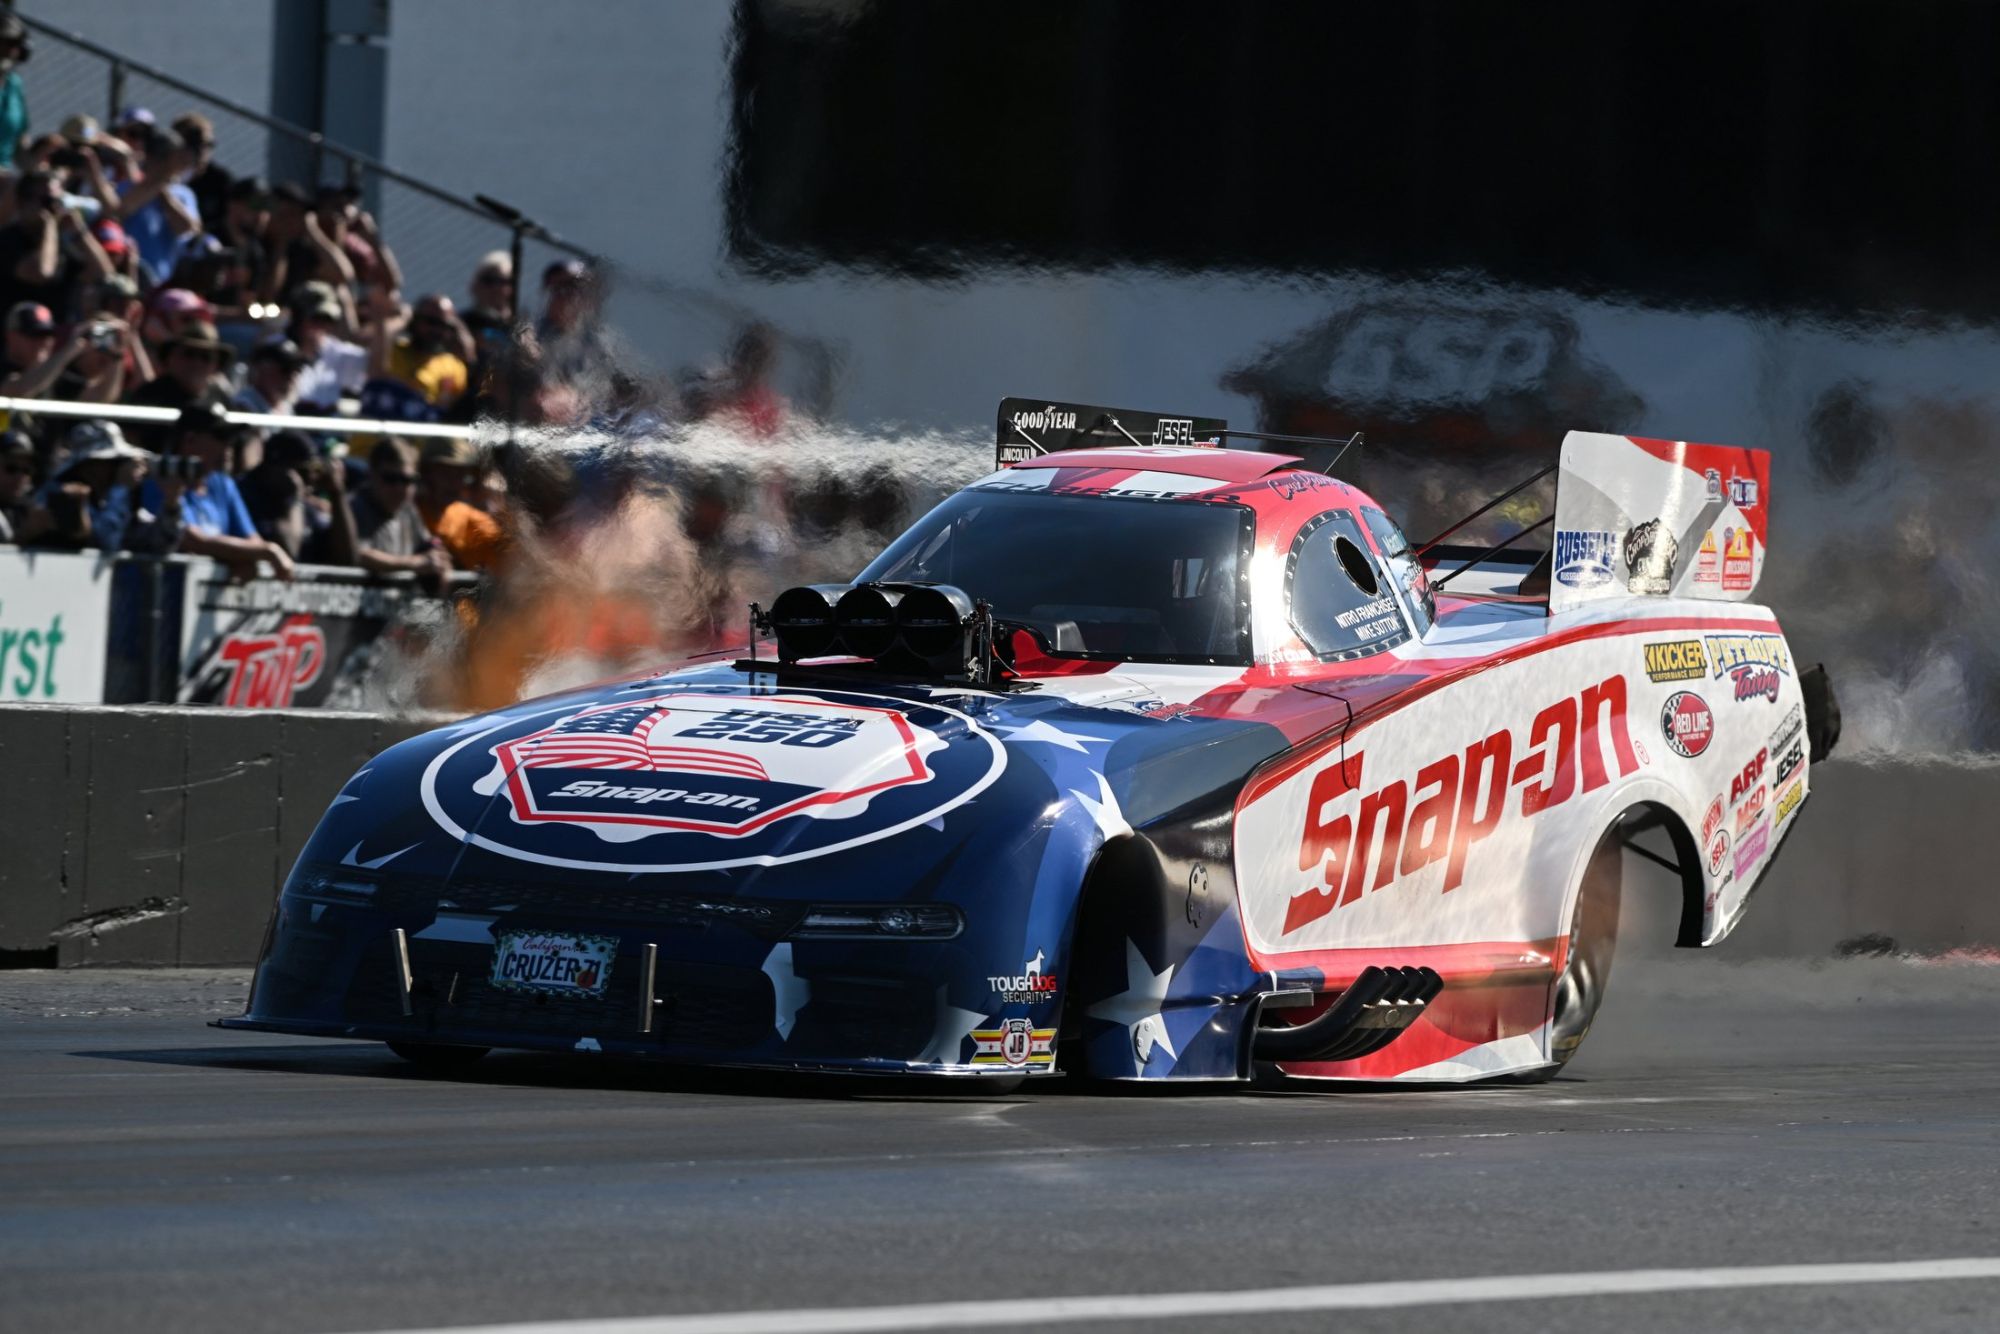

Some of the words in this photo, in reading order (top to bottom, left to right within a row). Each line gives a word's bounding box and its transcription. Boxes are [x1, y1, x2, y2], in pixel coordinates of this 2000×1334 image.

[1153, 418, 1195, 447] JESEL
[1000, 447, 1030, 462] LINCOLN
[1334, 609, 1360, 629] NITRO
[1357, 597, 1397, 623] FRANCHISEE
[1355, 623, 1377, 641] MIKE
[1375, 617, 1400, 636] SUTTON
[0, 612, 64, 697] rst
[1655, 641, 1706, 671] KICKER
[673, 721, 857, 748] 250
[713, 709, 865, 732] USA
[1676, 713, 1691, 735] RED
[1692, 711, 1710, 733] LINE
[1730, 747, 1767, 805] ARP
[502, 953, 580, 982] CRUZER
[1002, 991, 1045, 1003] SECURITY
